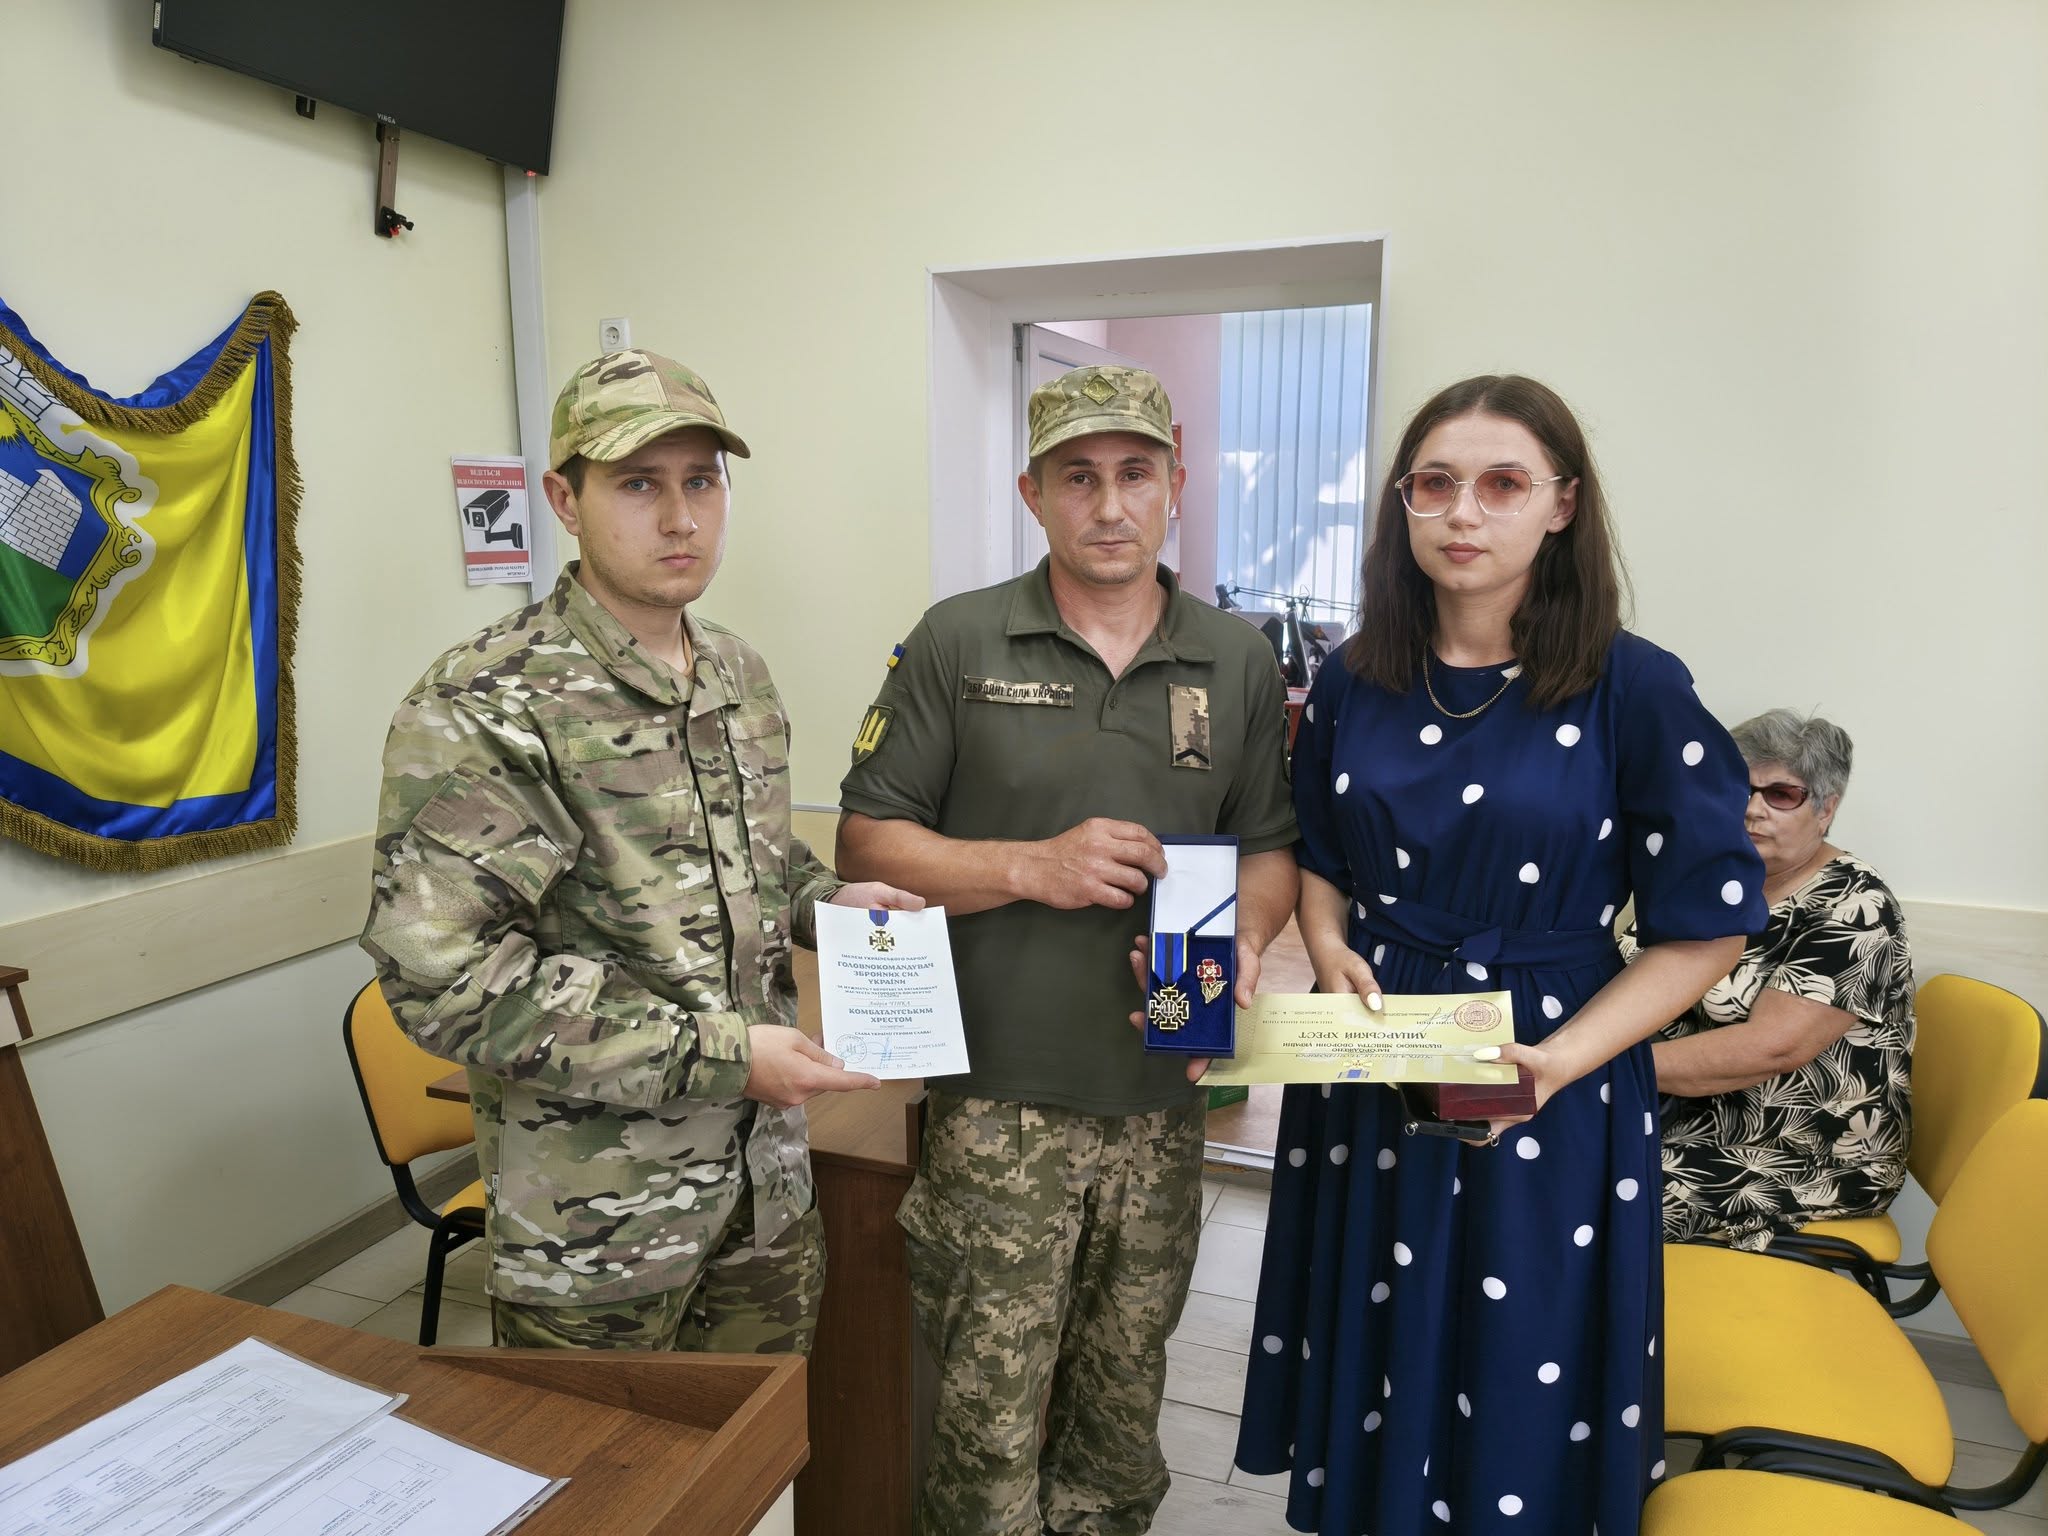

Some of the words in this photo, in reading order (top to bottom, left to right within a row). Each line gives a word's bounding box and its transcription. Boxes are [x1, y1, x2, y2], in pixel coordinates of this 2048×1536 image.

[377, 112, 396, 125] VINGA
[968, 683, 1004, 696] ЗБРОЙНІ
[1006, 687, 1030, 698] СИЛИ
[1032, 688, 1071, 700] УКРАЇНИ
[837, 961, 934, 970] ГОЛОВНОКОМАНДУВАЧ
[853, 970, 900, 978] ЗБРОЙНИХ
[1345, 1031, 1427, 1039] ЛИЦАРСЬКИЙ
